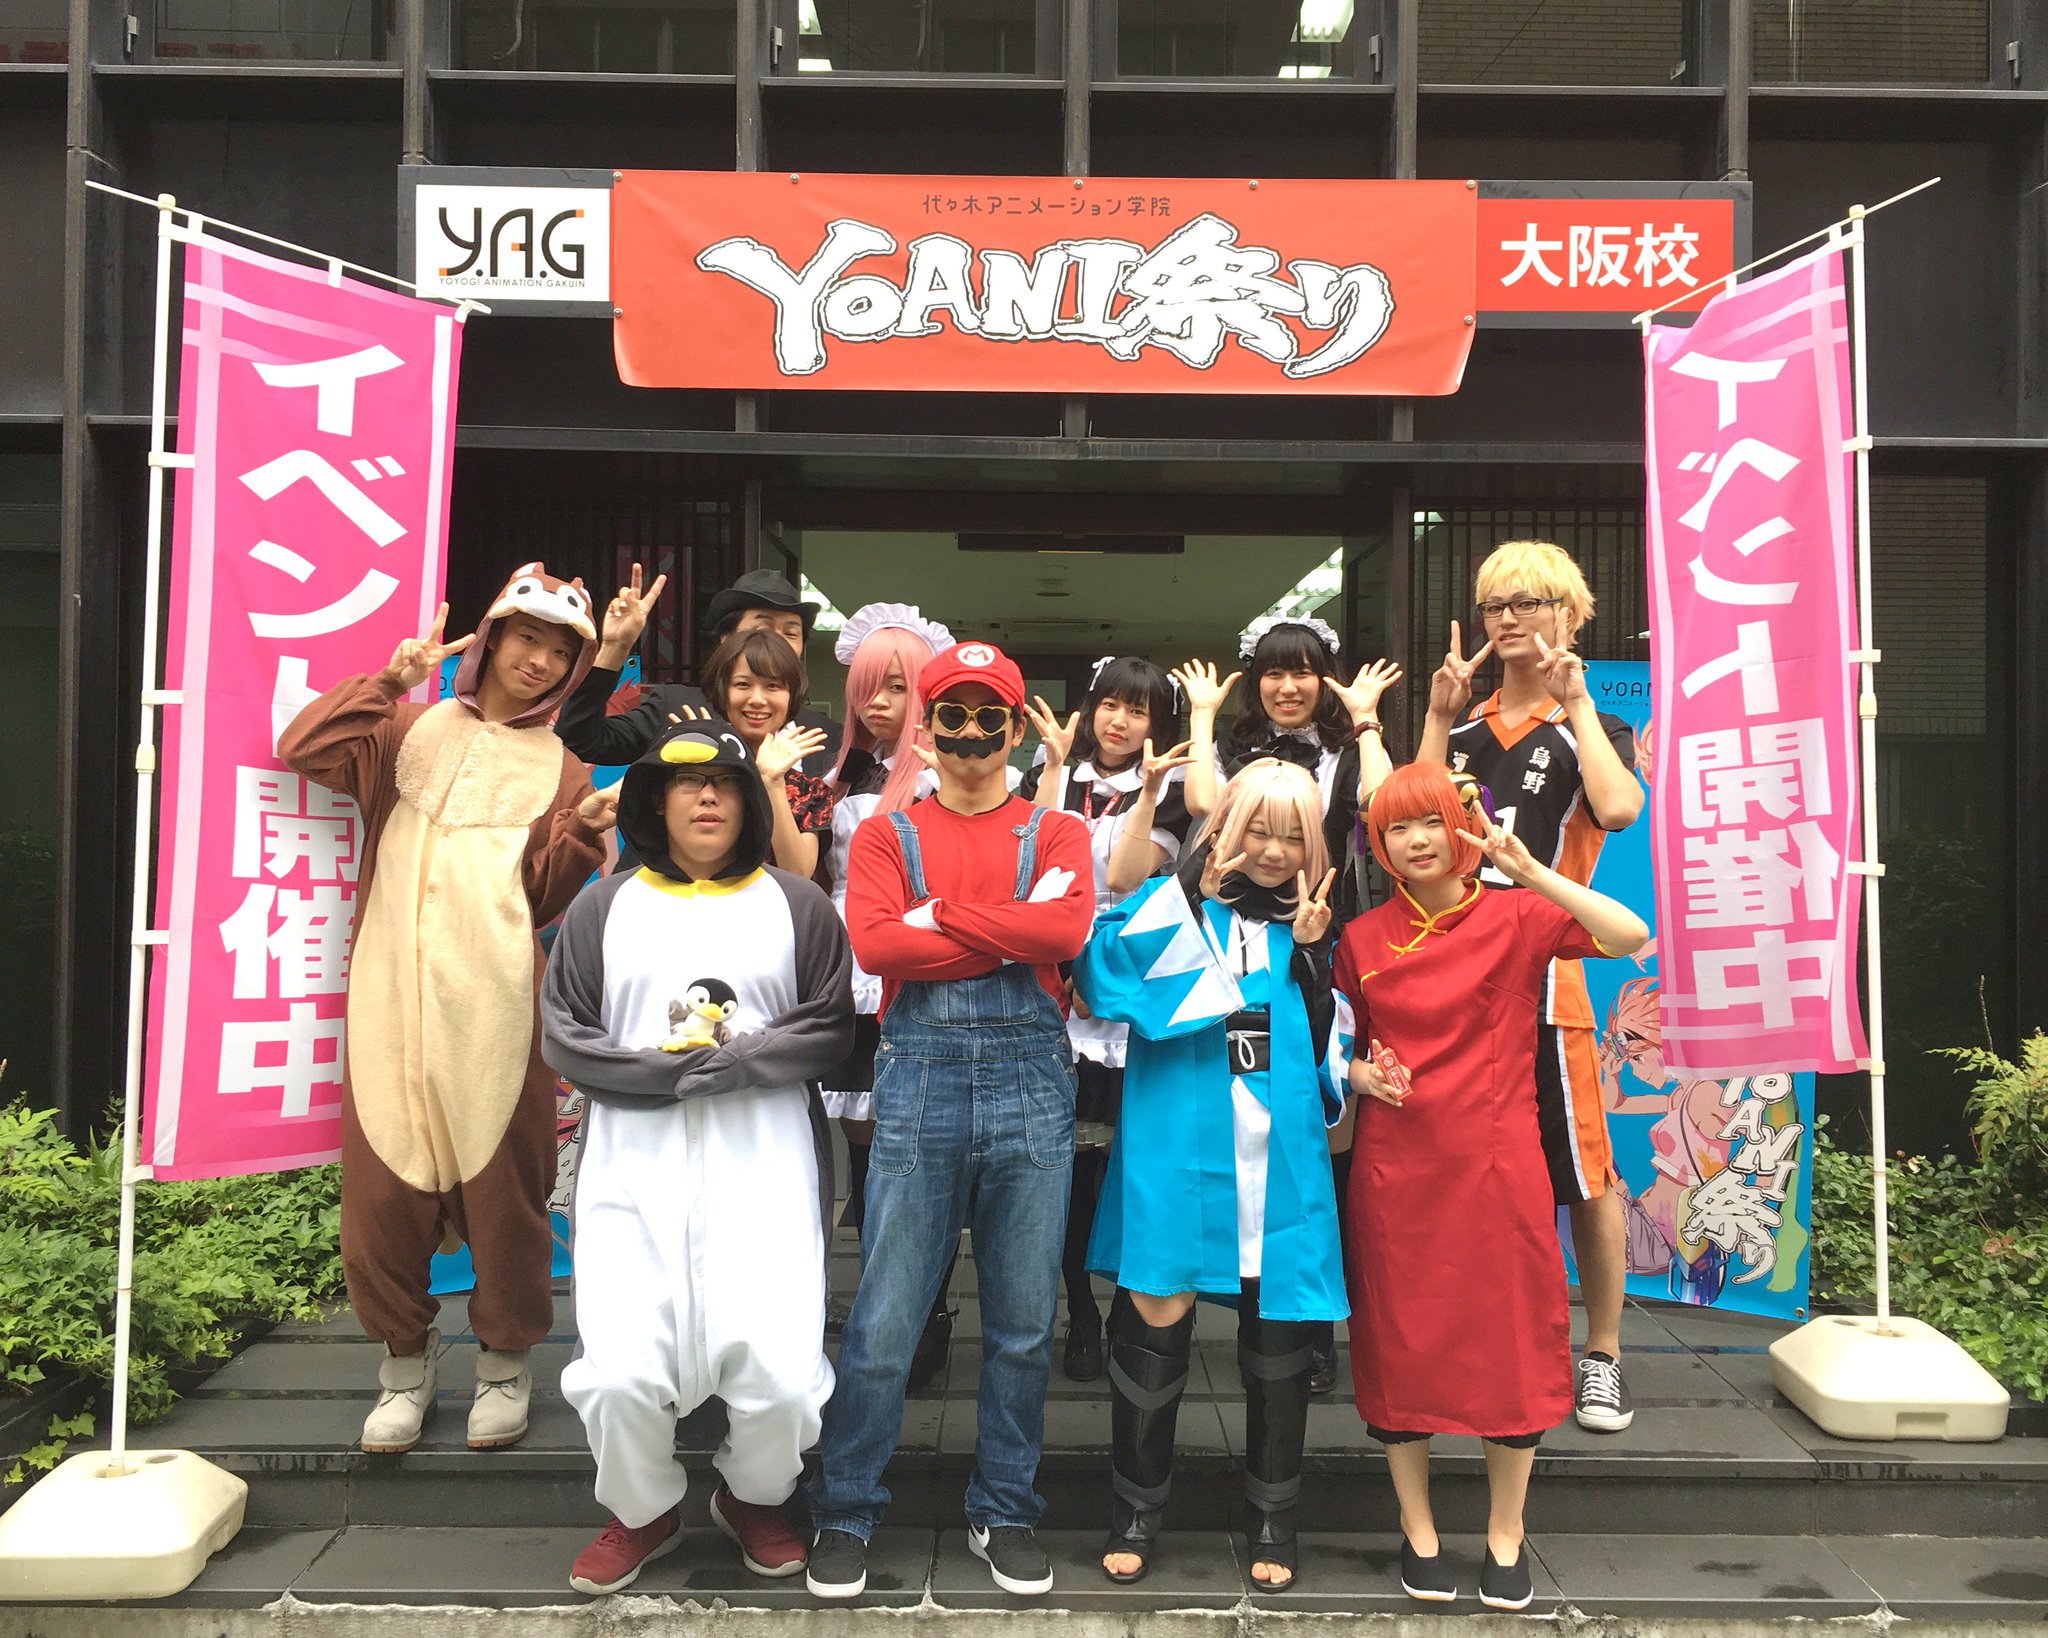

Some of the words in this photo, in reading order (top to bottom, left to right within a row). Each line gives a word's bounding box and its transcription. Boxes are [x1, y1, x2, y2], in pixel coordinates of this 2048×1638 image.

[922, 194, 1171, 217] 代々木アニメーション学院
[1500, 222, 1700, 288] 大阪校
[439, 277, 481, 286] YOYOGI
[484, 278, 543, 288] ANIMATION
[546, 279, 585, 288] GAKUIN
